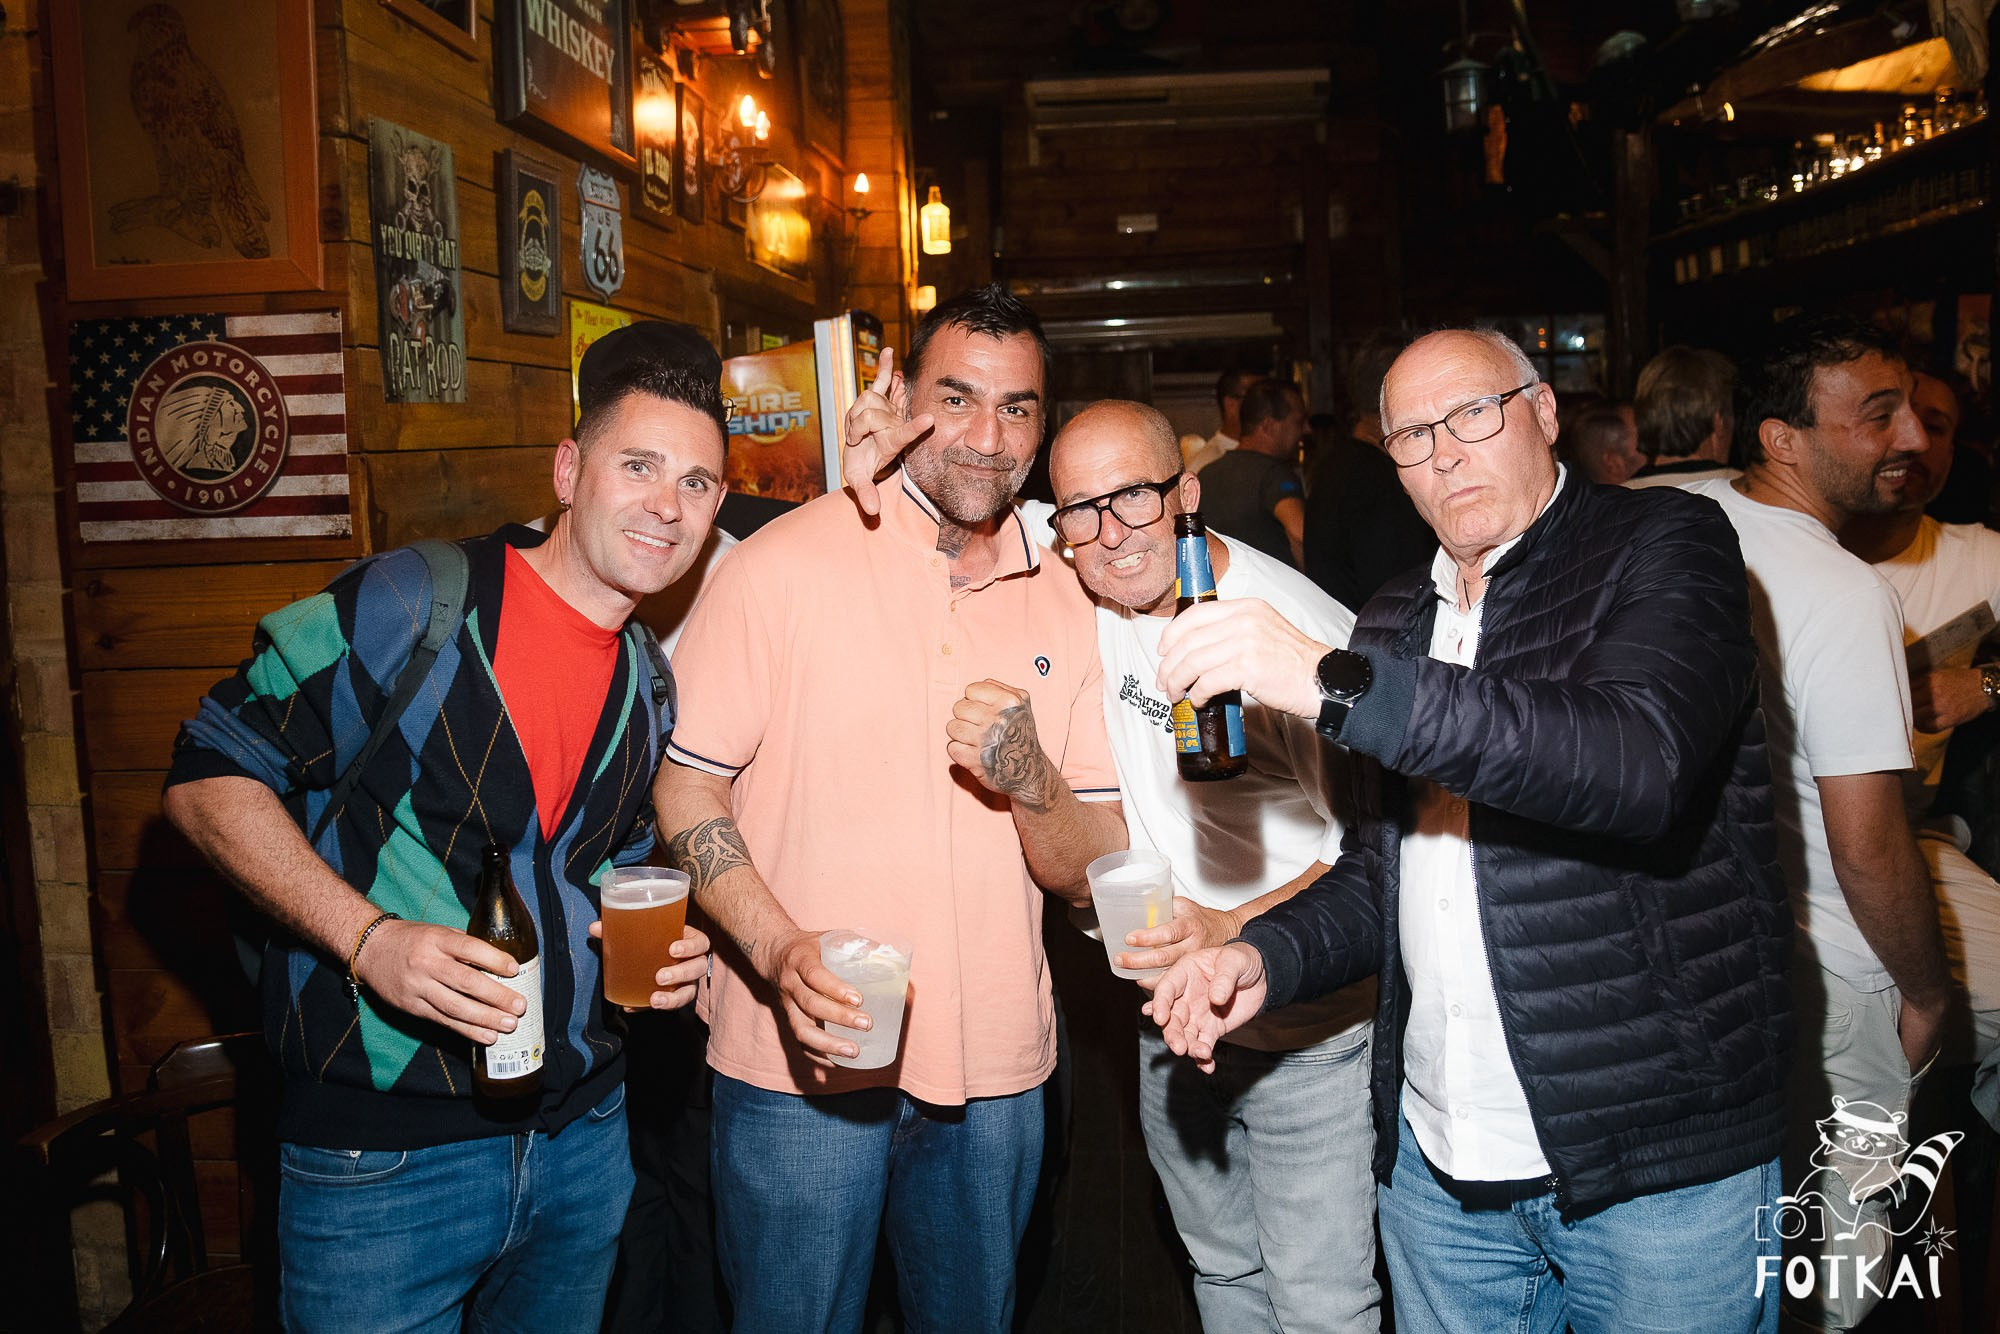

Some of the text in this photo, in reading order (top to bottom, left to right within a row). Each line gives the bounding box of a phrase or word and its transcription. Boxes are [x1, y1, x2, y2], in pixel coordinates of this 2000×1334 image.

[527, 0, 615, 86] WHISKEY
[381, 223, 457, 269] YOU DIRTY RAT
[594, 227, 620, 285] 66
[388, 332, 462, 397] RAT ROD
[136, 350, 281, 477] INDIAN MOTORCYCLE
[729, 410, 812, 435] SHOT
[732, 392, 802, 417] FIRE
[184, 485, 239, 504] 1901
